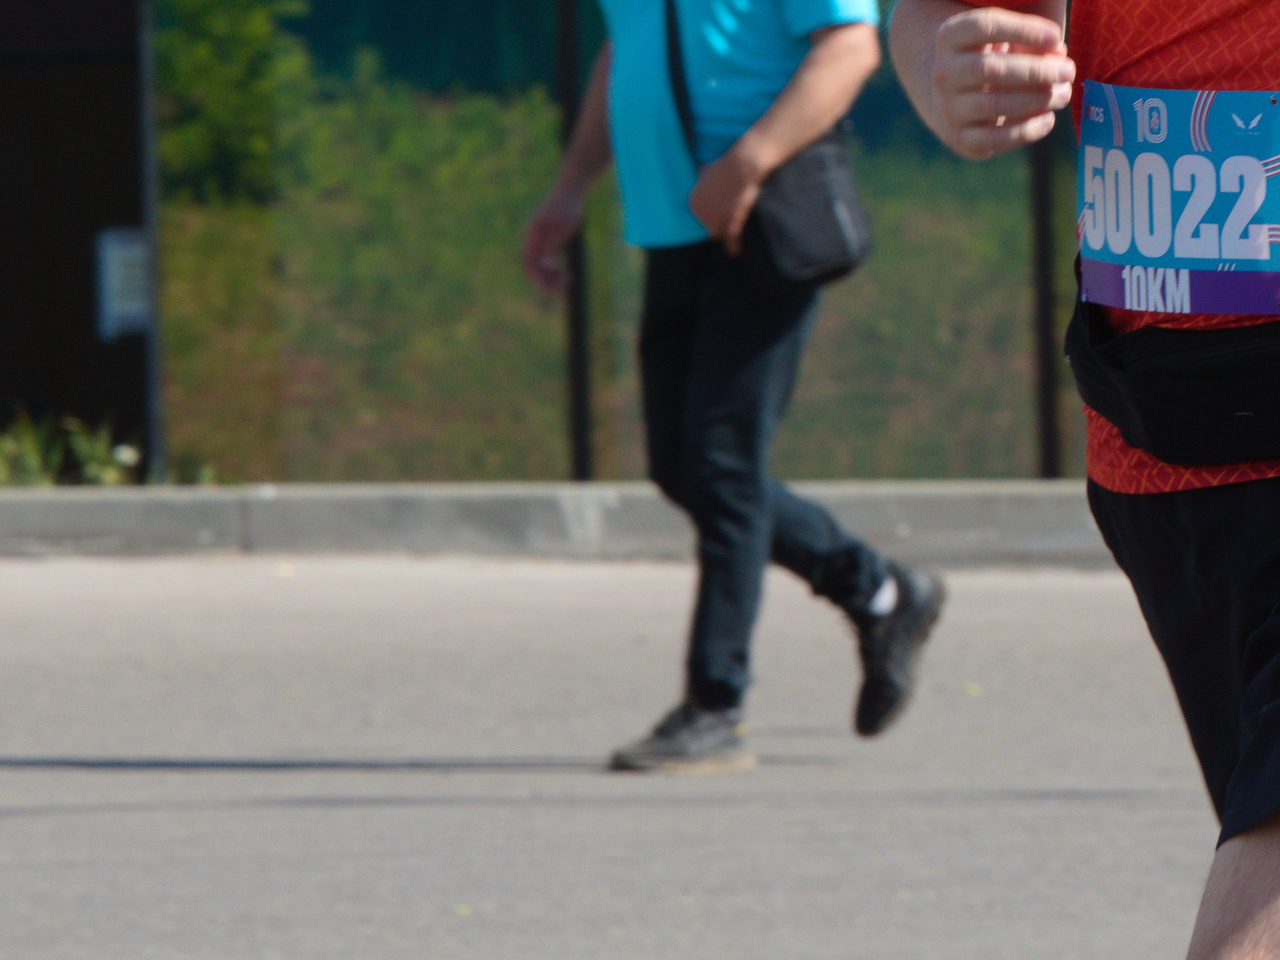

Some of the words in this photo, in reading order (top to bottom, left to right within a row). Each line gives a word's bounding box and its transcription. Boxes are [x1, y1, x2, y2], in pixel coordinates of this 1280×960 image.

[1132, 97, 1168, 143] 10
[1083, 145, 1271, 260] 50022
[1121, 264, 1191, 313] 10KM
